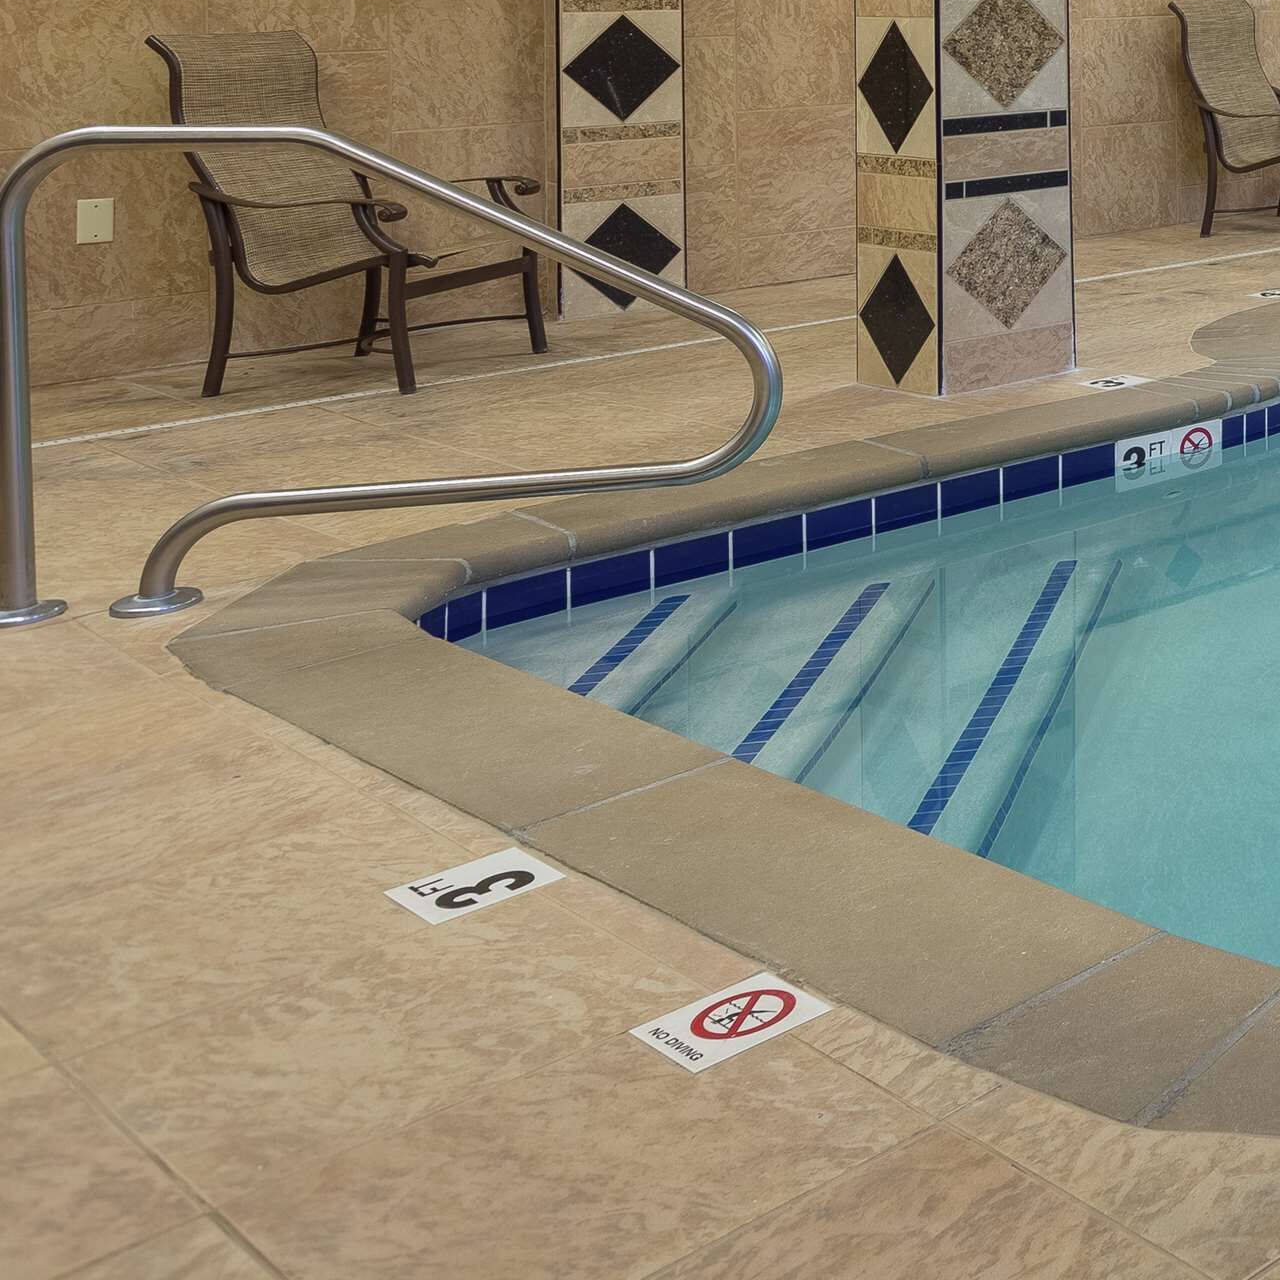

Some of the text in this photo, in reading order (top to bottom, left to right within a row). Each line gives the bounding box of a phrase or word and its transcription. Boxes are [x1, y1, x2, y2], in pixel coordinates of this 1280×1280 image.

[1122, 440, 1166, 470] 3 FT
[408, 870, 535, 910] 3 FT
[648, 1027, 704, 1062] NO DIVING
